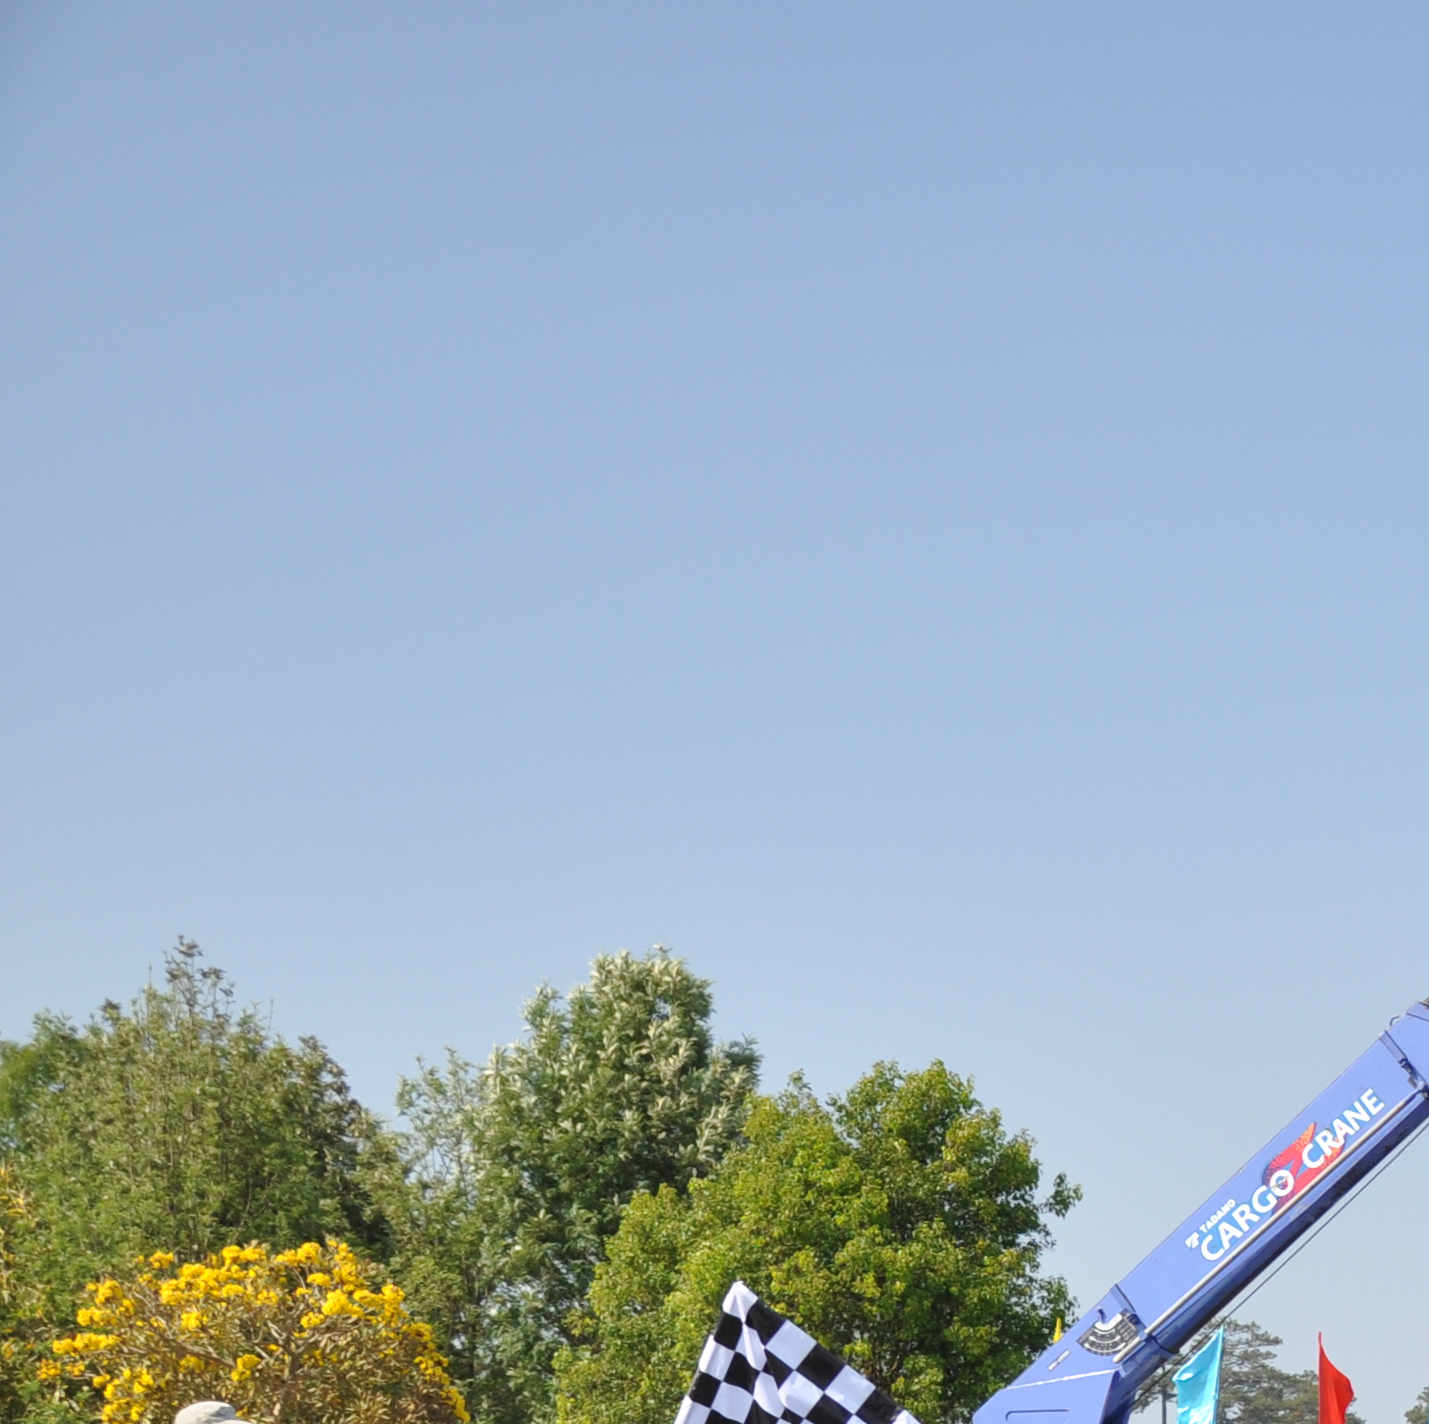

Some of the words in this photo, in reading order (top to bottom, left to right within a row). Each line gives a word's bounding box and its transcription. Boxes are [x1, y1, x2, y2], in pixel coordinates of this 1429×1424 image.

[1199, 1199, 1236, 1233] TADANO
[1201, 1170, 1294, 1261] CARGO
[1302, 1088, 1385, 1169] CRANE
